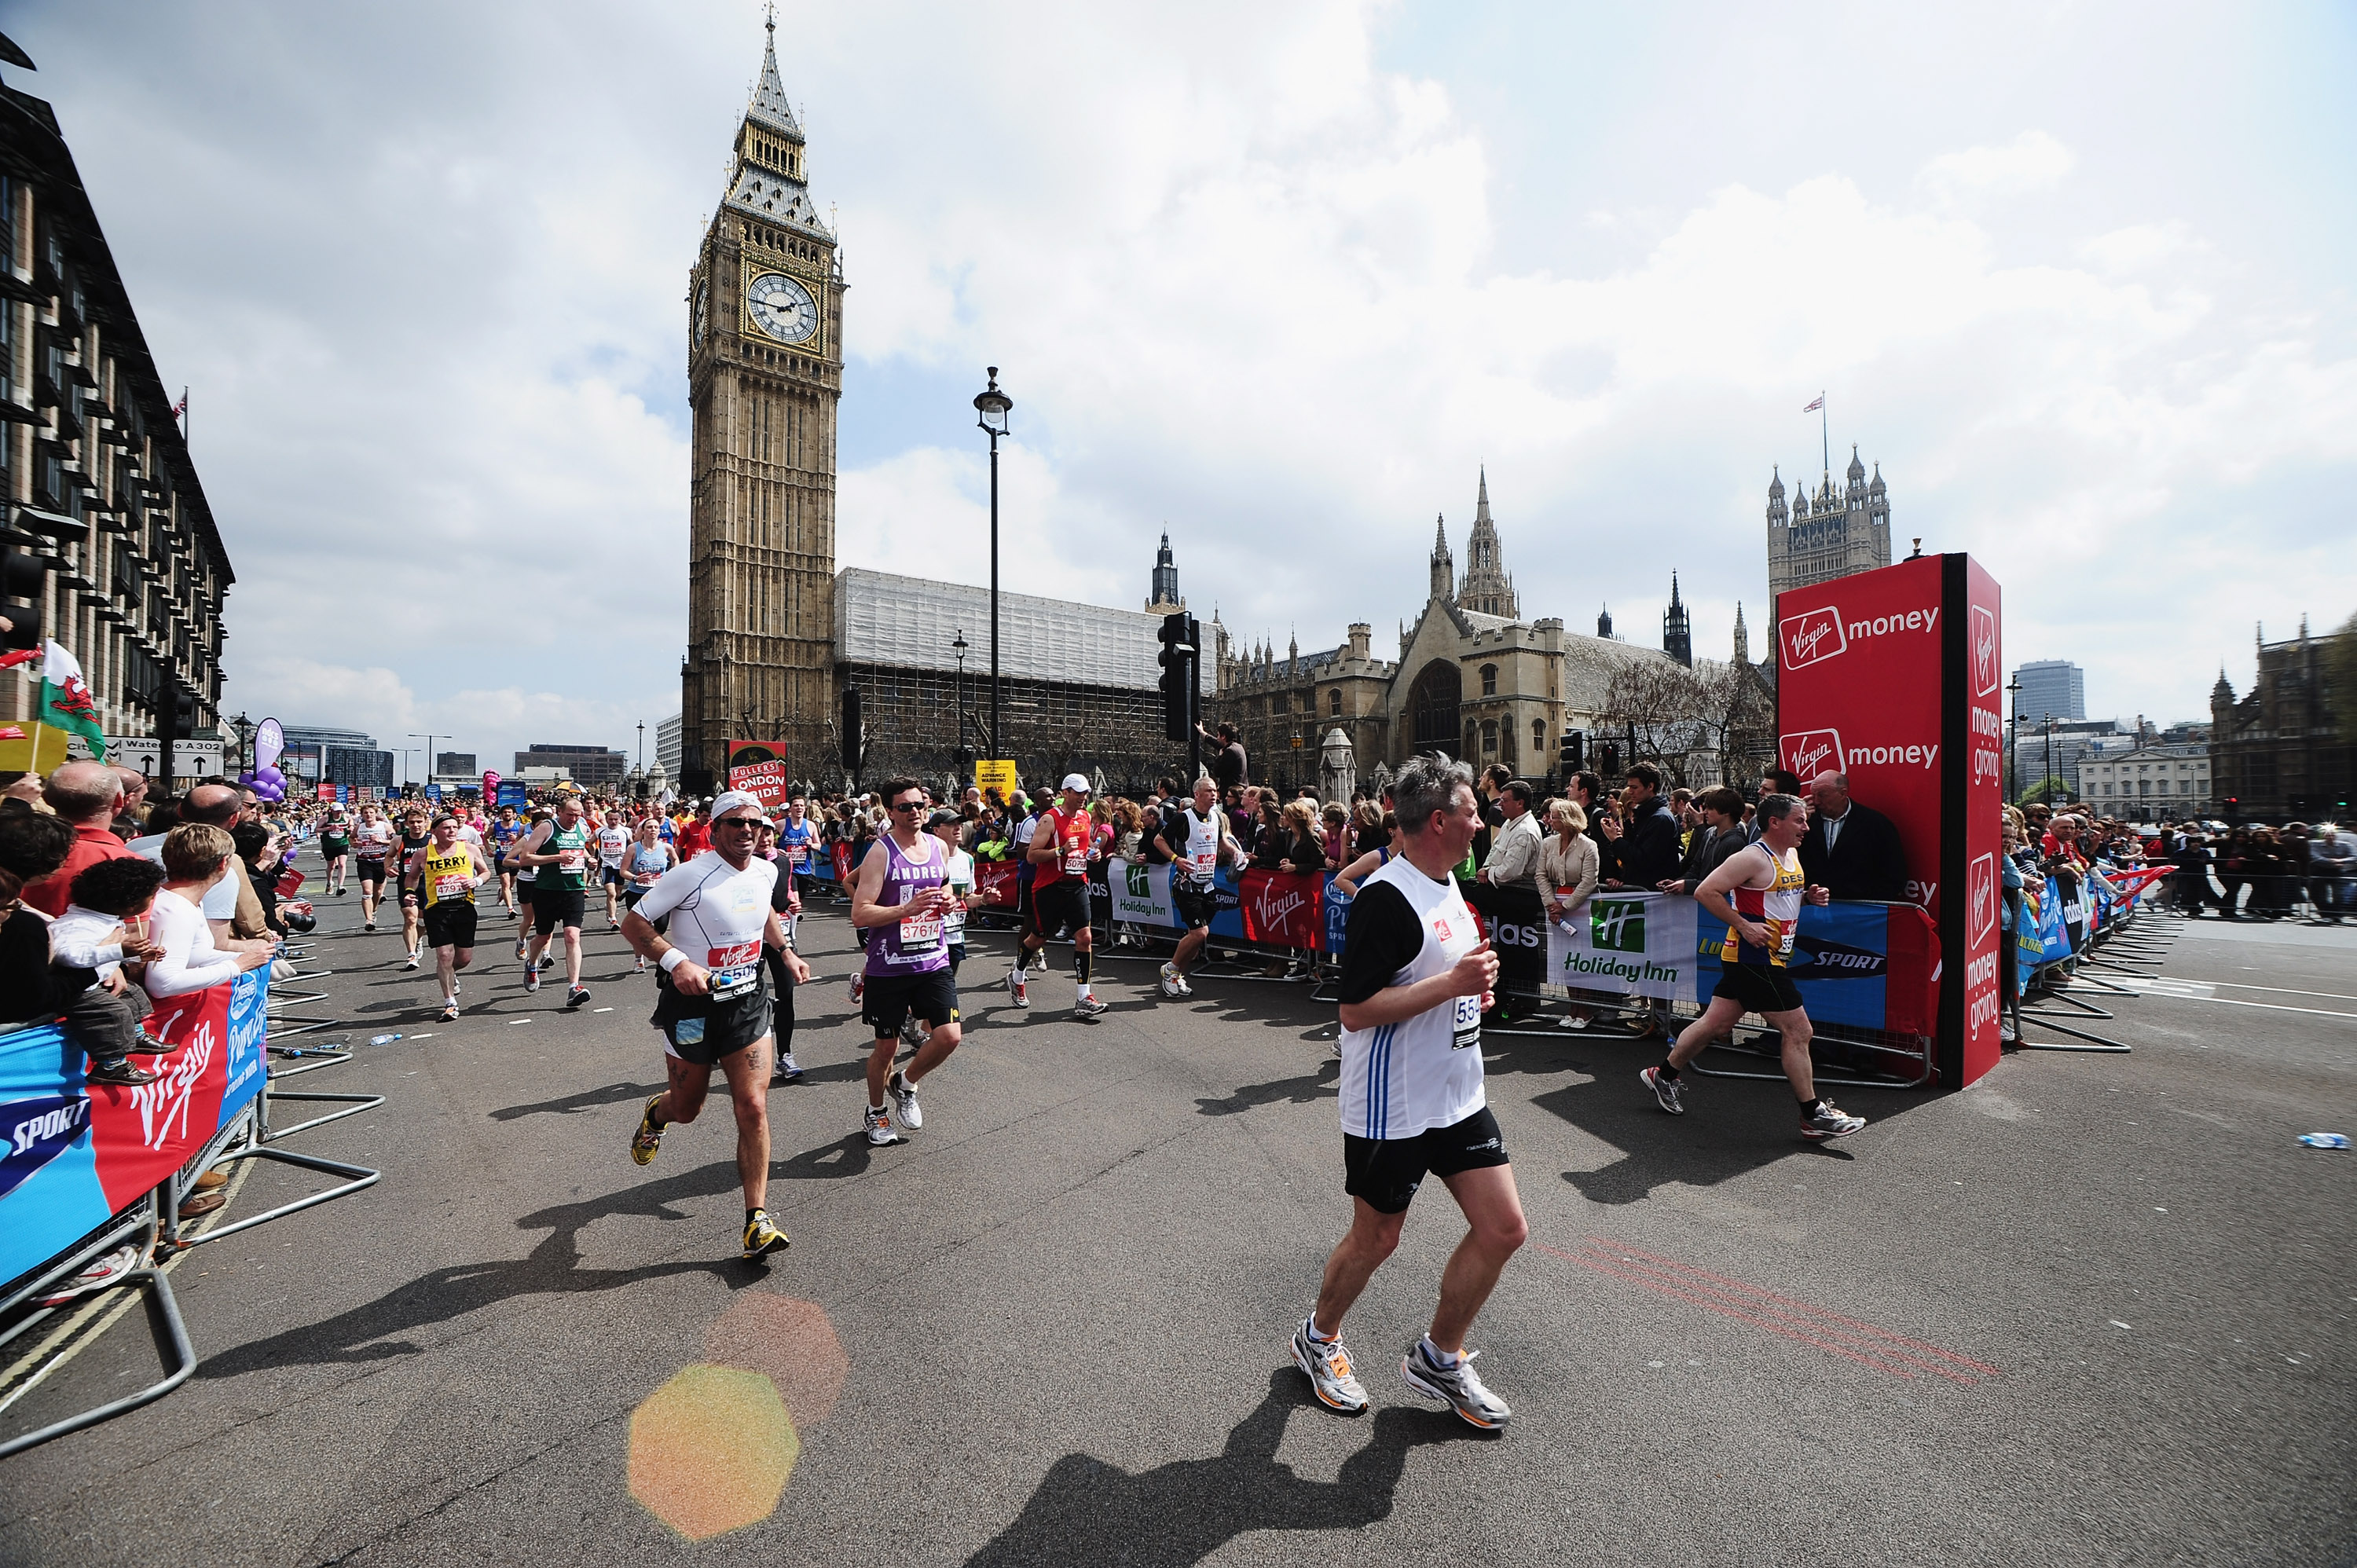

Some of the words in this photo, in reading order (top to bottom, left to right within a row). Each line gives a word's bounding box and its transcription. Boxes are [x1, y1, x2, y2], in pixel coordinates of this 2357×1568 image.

[1791, 617, 1832, 659] Virgin
[1849, 606, 1939, 640] money
[1977, 614, 1993, 687] Virgin
[1972, 705, 2000, 748] money
[126, 740, 181, 749] Wateo
[1791, 735, 1832, 778] Virgin
[1849, 744, 1938, 769] money
[734, 763, 775, 777] FULLER'S
[1974, 741, 2000, 787] giving
[752, 786, 781, 799] RIDE
[427, 855, 467, 870] TERRY
[438, 885, 467, 893] 4791
[1780, 874, 1804, 885] DES
[1119, 898, 1153, 917] Holiday
[1152, 902, 1166, 916] Inn
[1215, 893, 1239, 905] SPORT
[1255, 877, 1306, 936] Virgin
[1973, 863, 1990, 933] Virgin
[2063, 899, 2082, 925] adidas
[902, 923, 940, 939] 37614
[720, 945, 753, 967] Virgin
[1563, 951, 1641, 983] Holiday
[1644, 961, 1678, 983] Inn
[1813, 951, 1885, 970] SPORT
[1967, 949, 1998, 991] money
[1970, 987, 1999, 1042] giving
[130, 1009, 215, 1152] Virgin
[12, 1097, 91, 1157] SPORT
